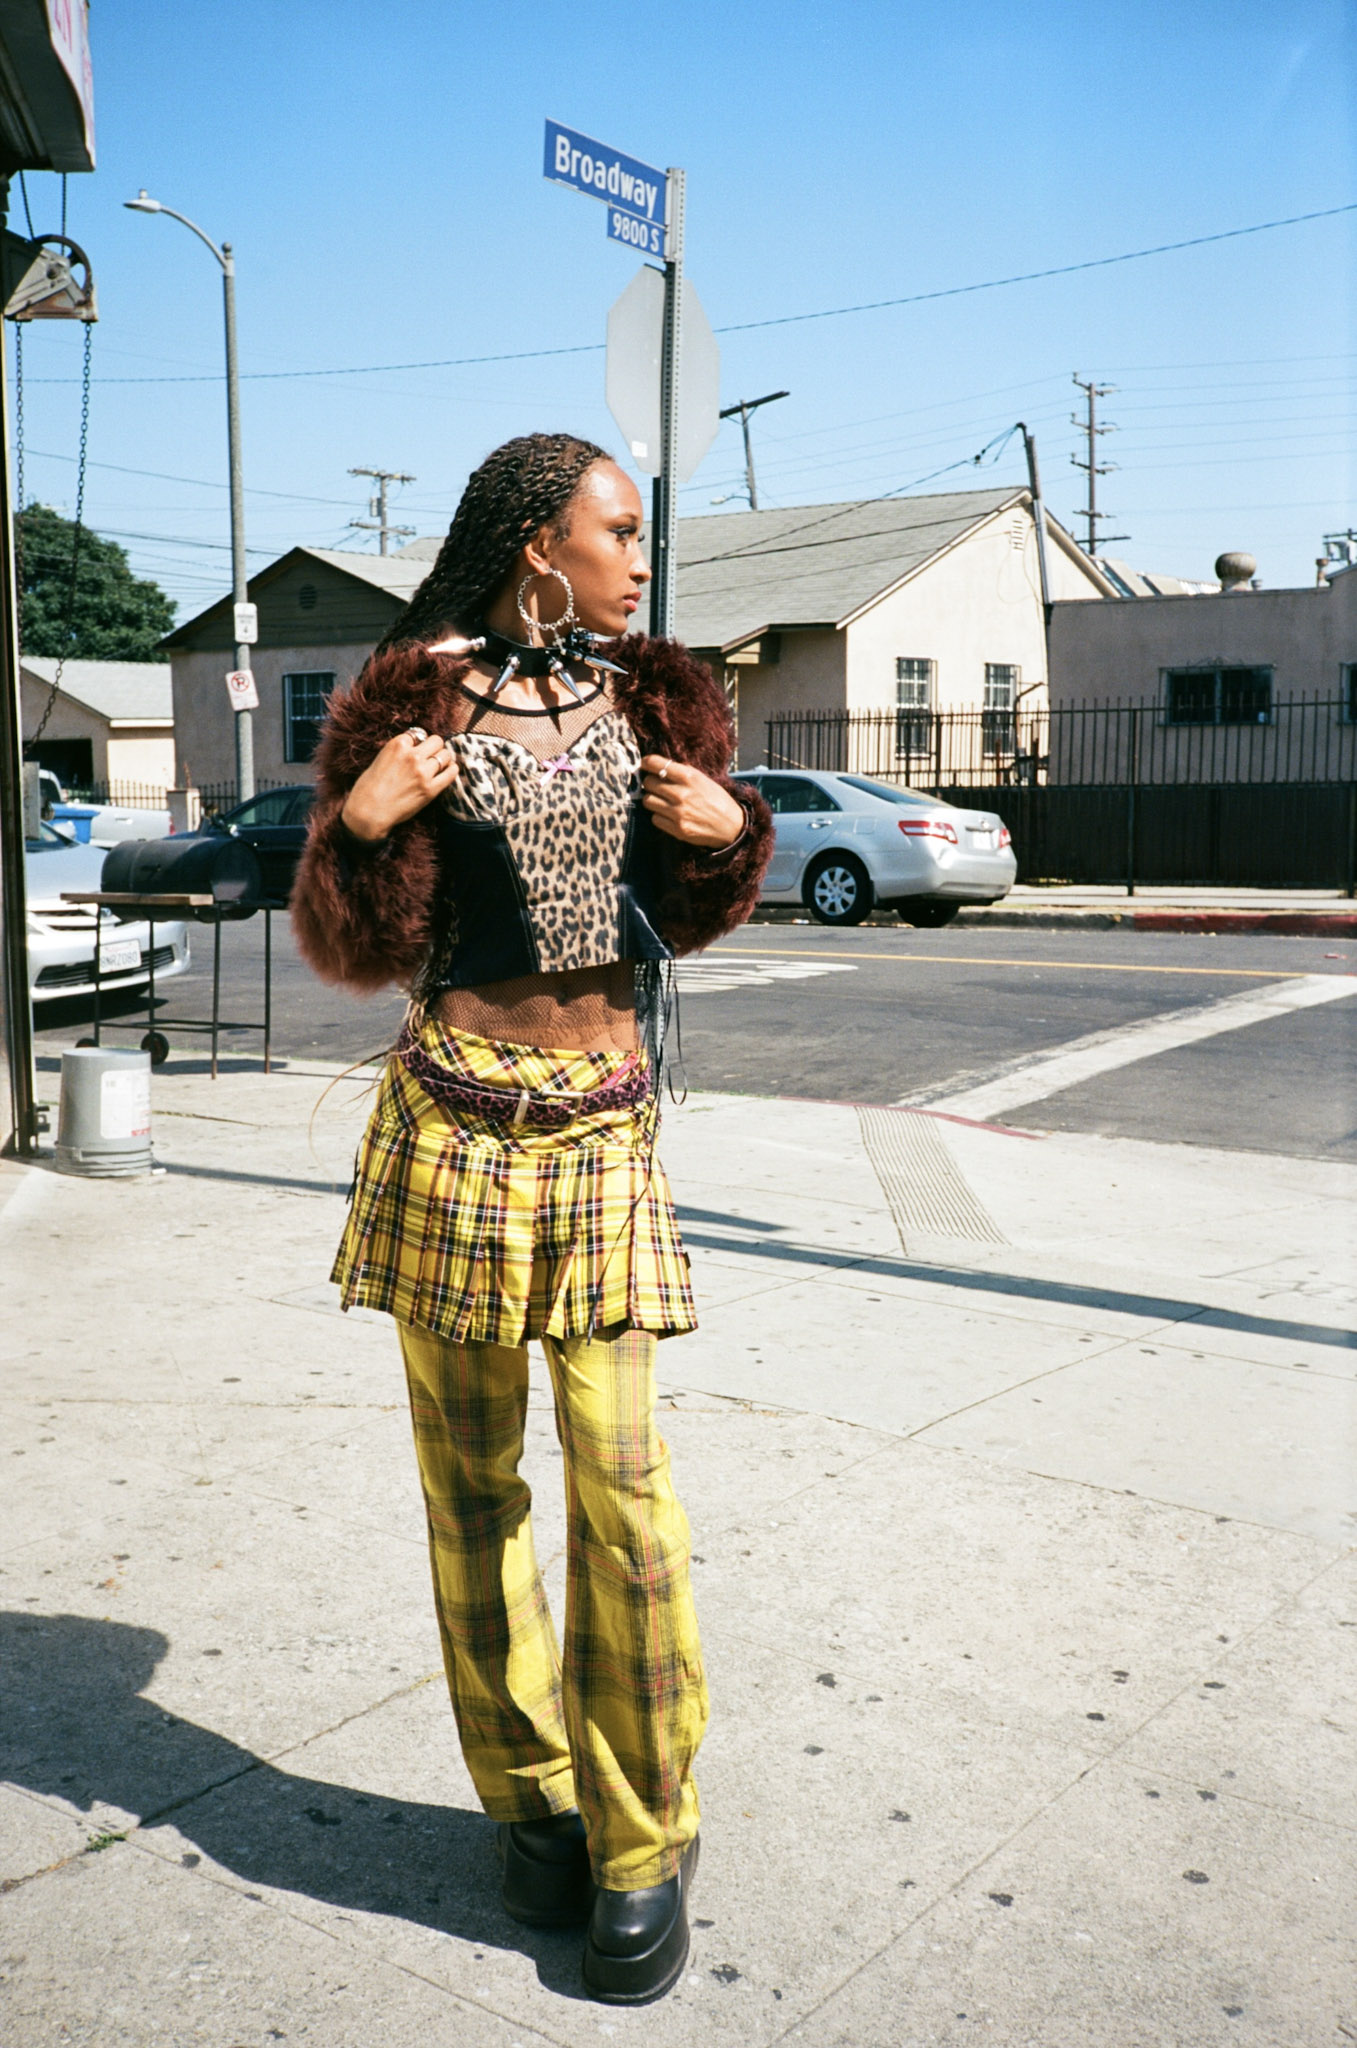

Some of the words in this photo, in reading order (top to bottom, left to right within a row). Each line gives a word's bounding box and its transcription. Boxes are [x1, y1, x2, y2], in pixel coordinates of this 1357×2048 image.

[555, 134, 658, 219] Broadway
[613, 213, 648, 248] 9800
[650, 228, 660, 253] S
